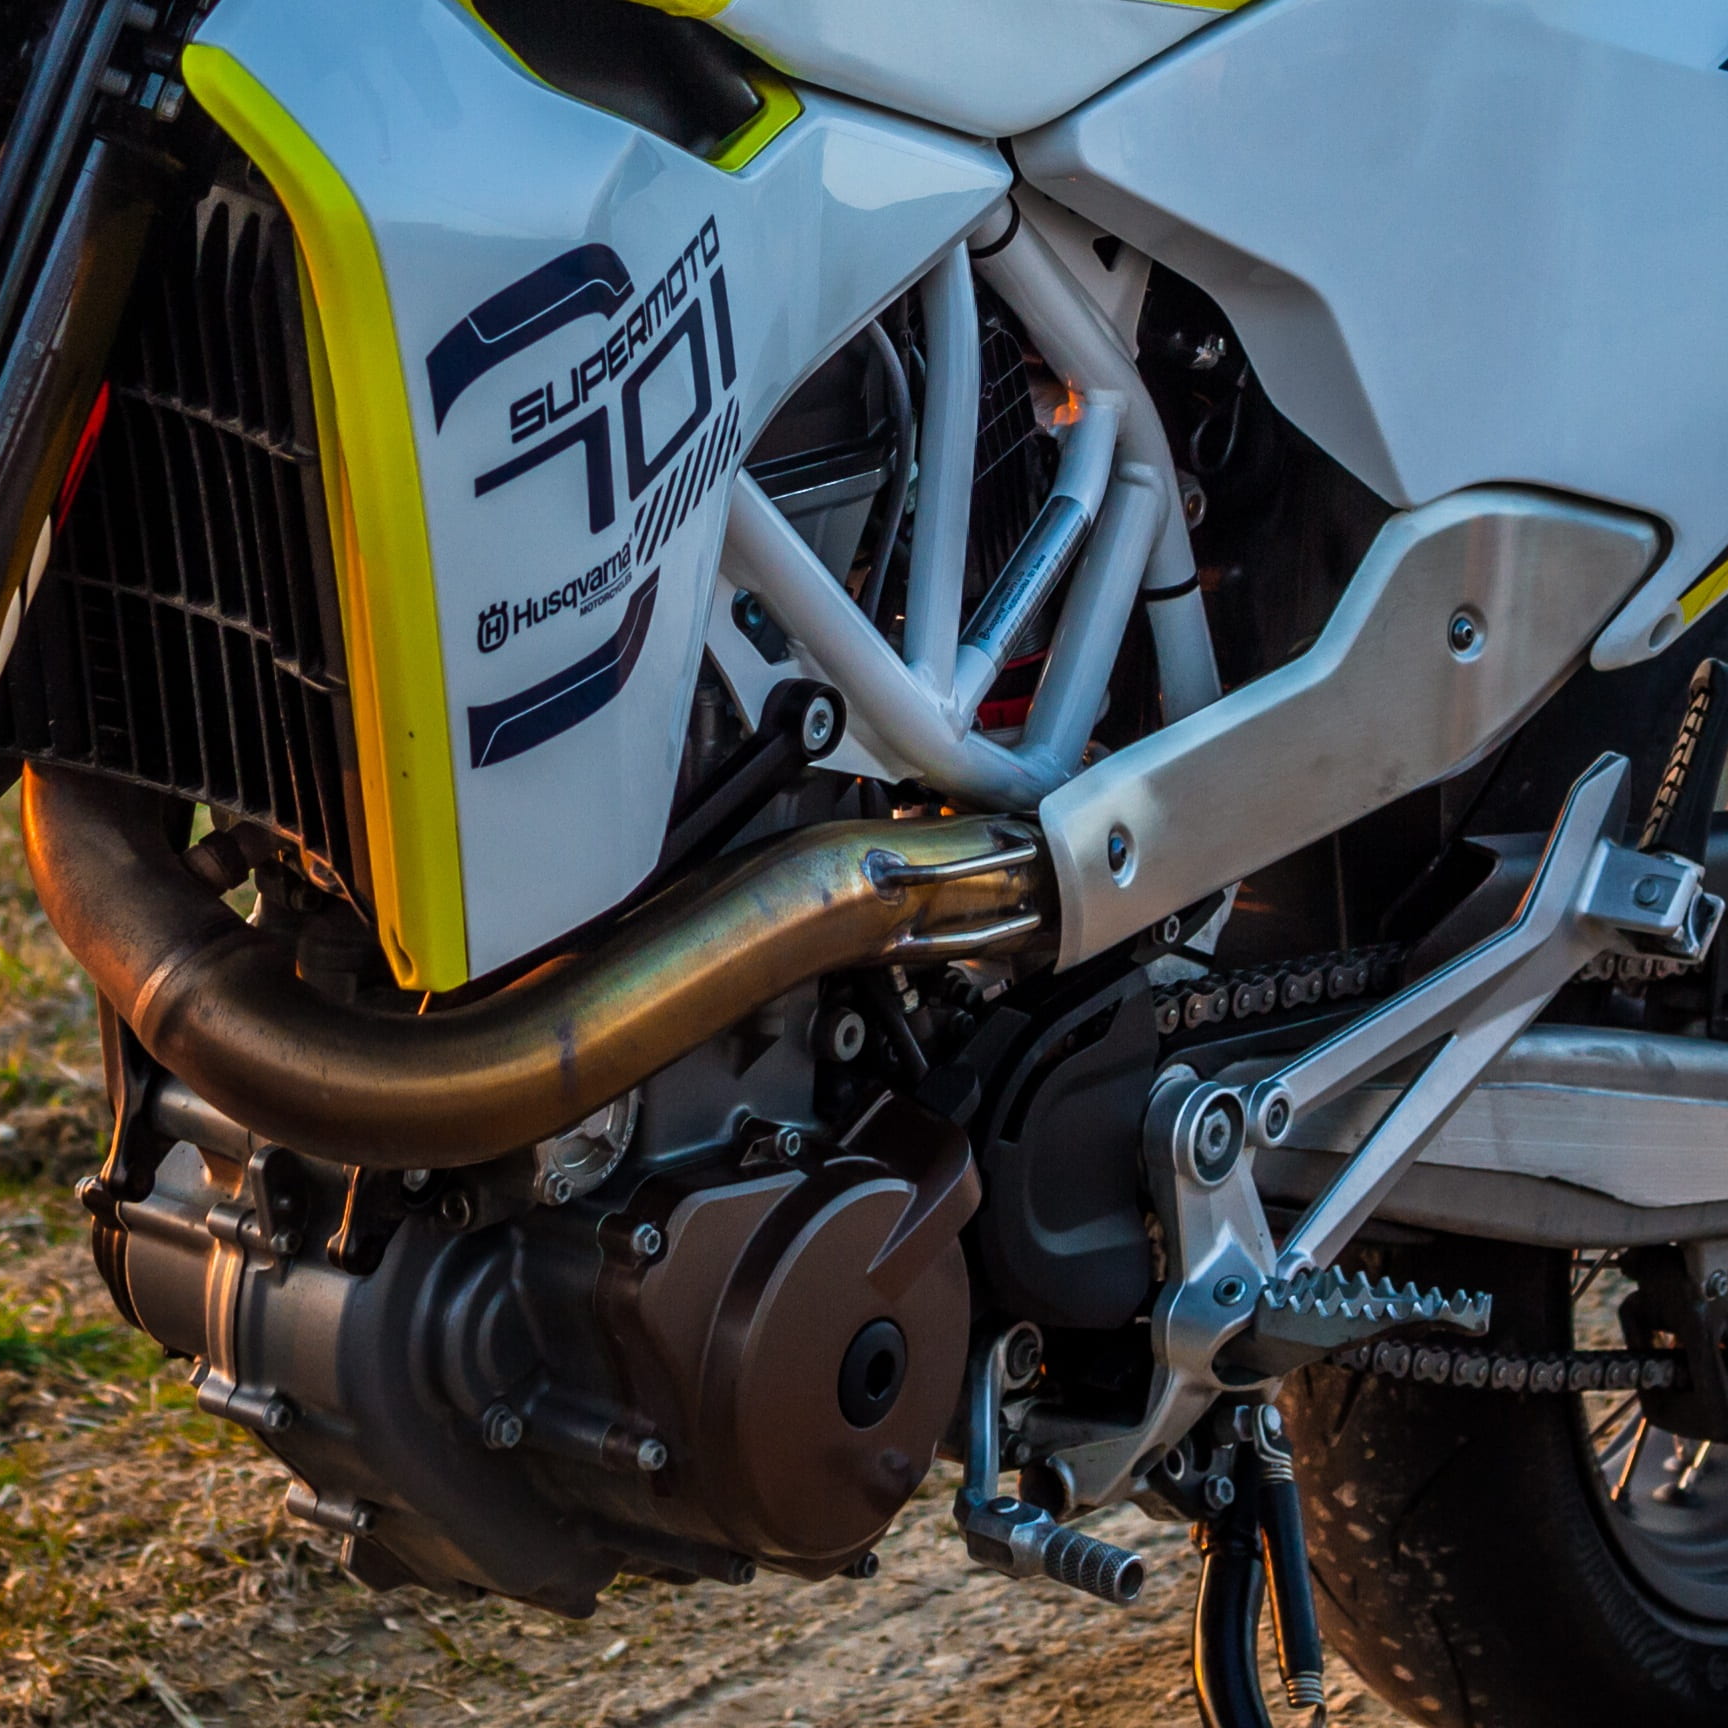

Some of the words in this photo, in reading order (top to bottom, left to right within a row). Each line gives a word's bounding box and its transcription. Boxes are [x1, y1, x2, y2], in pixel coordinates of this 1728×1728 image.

[475, 263, 737, 535] 701
[510, 214, 721, 444] SUPERMOTO
[513, 542, 632, 635] Husqvarna
[579, 571, 632, 617] MOTORCYCLES
